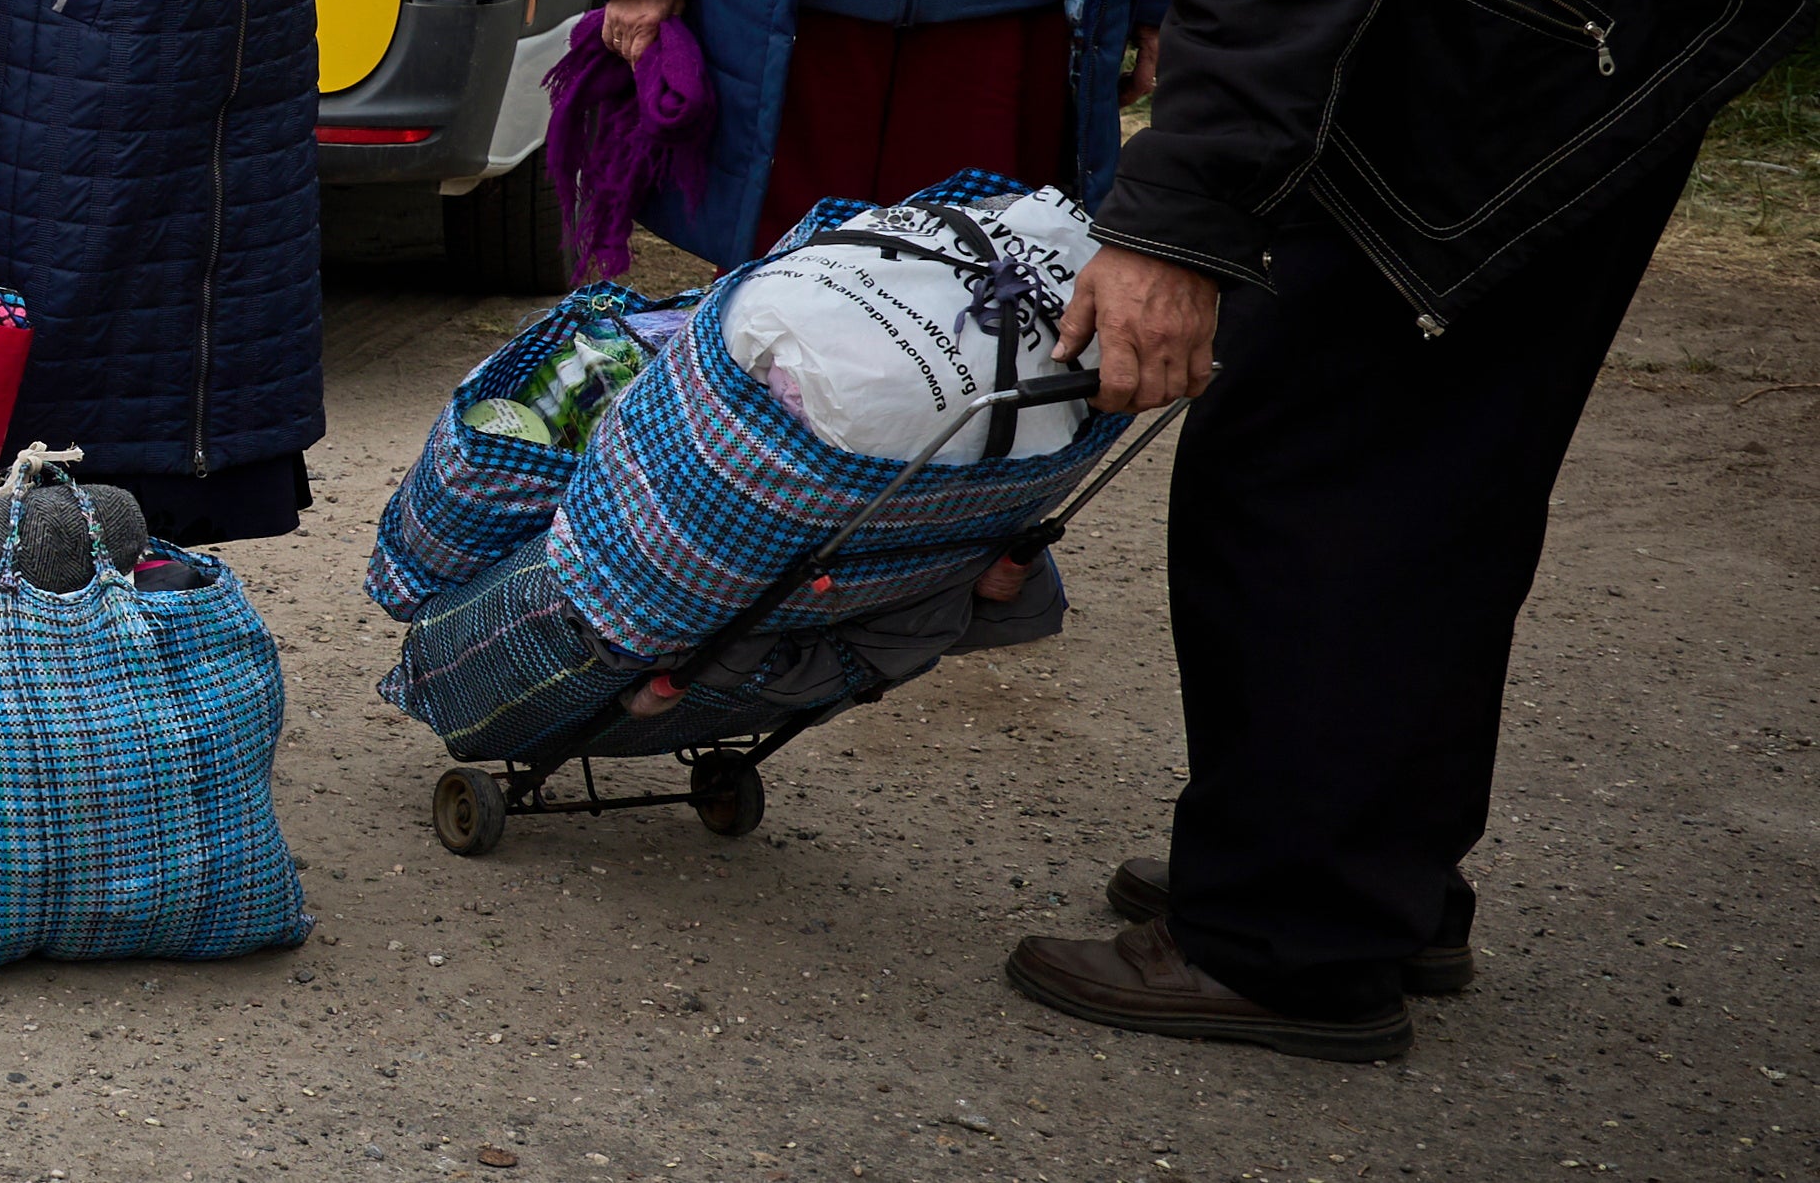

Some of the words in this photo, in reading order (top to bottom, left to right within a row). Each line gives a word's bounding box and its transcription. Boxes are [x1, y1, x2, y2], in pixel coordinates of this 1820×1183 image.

[810, 272, 899, 338] уманітарна
[895, 338, 948, 413] допомога
[877, 288, 978, 396] www.WCK.org
